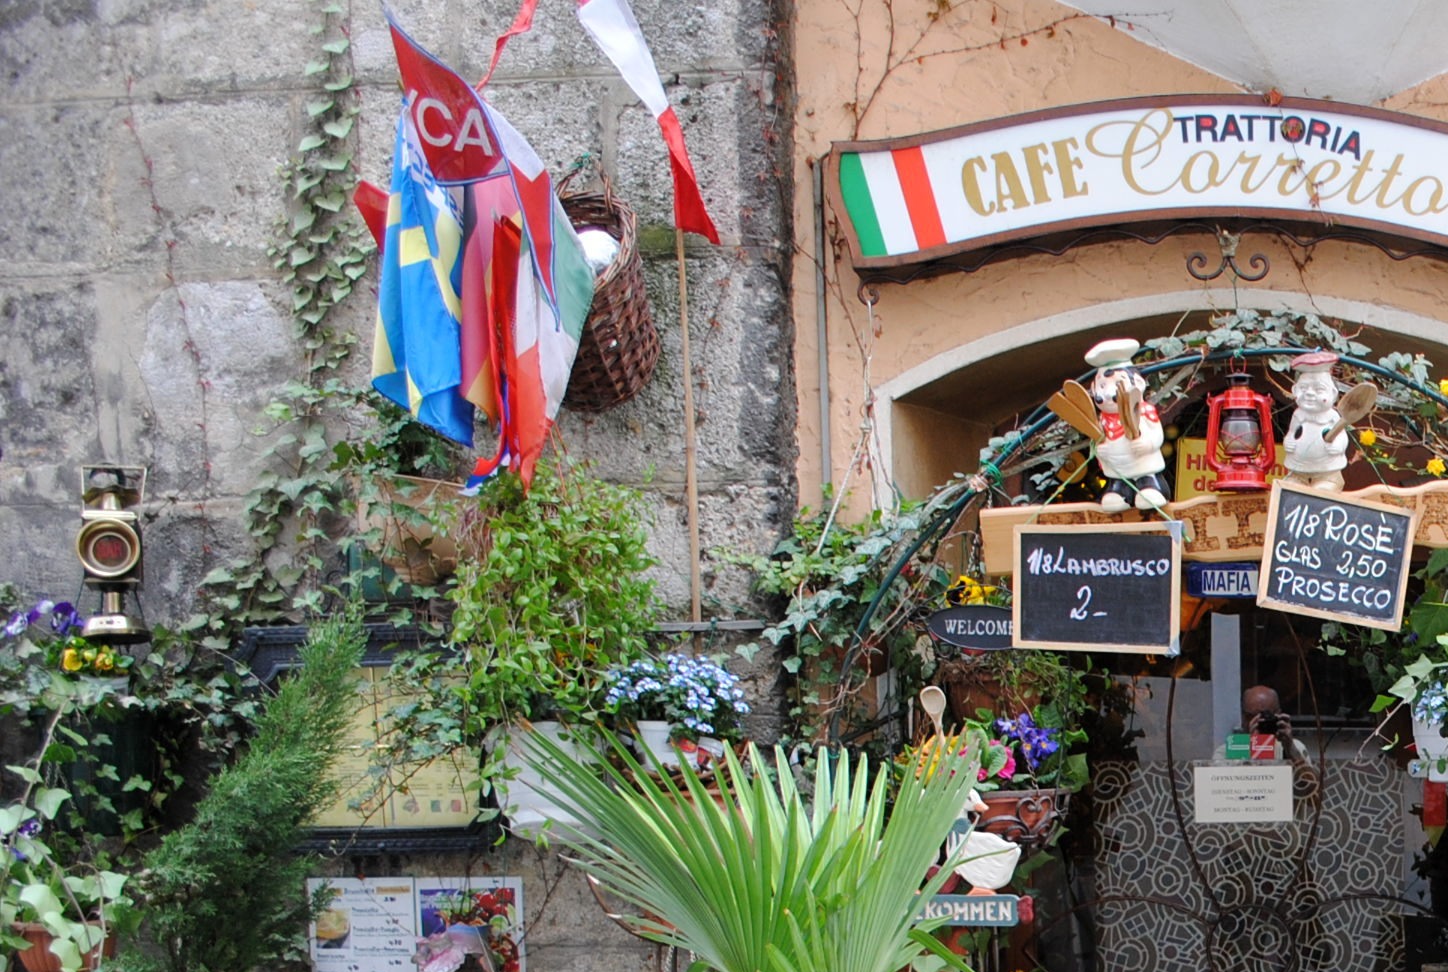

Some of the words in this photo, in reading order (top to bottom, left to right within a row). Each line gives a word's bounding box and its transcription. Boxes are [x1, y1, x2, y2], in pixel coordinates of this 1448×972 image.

[1173, 113, 1364, 160] TRATTORIA
[960, 135, 1091, 218] CAFE
[1275, 540, 1322, 570] GLAS
[1336, 550, 1388, 579] 2,50
[1203, 571, 1252, 593] MAFIA
[1274, 566, 1392, 610] PROSECCO
